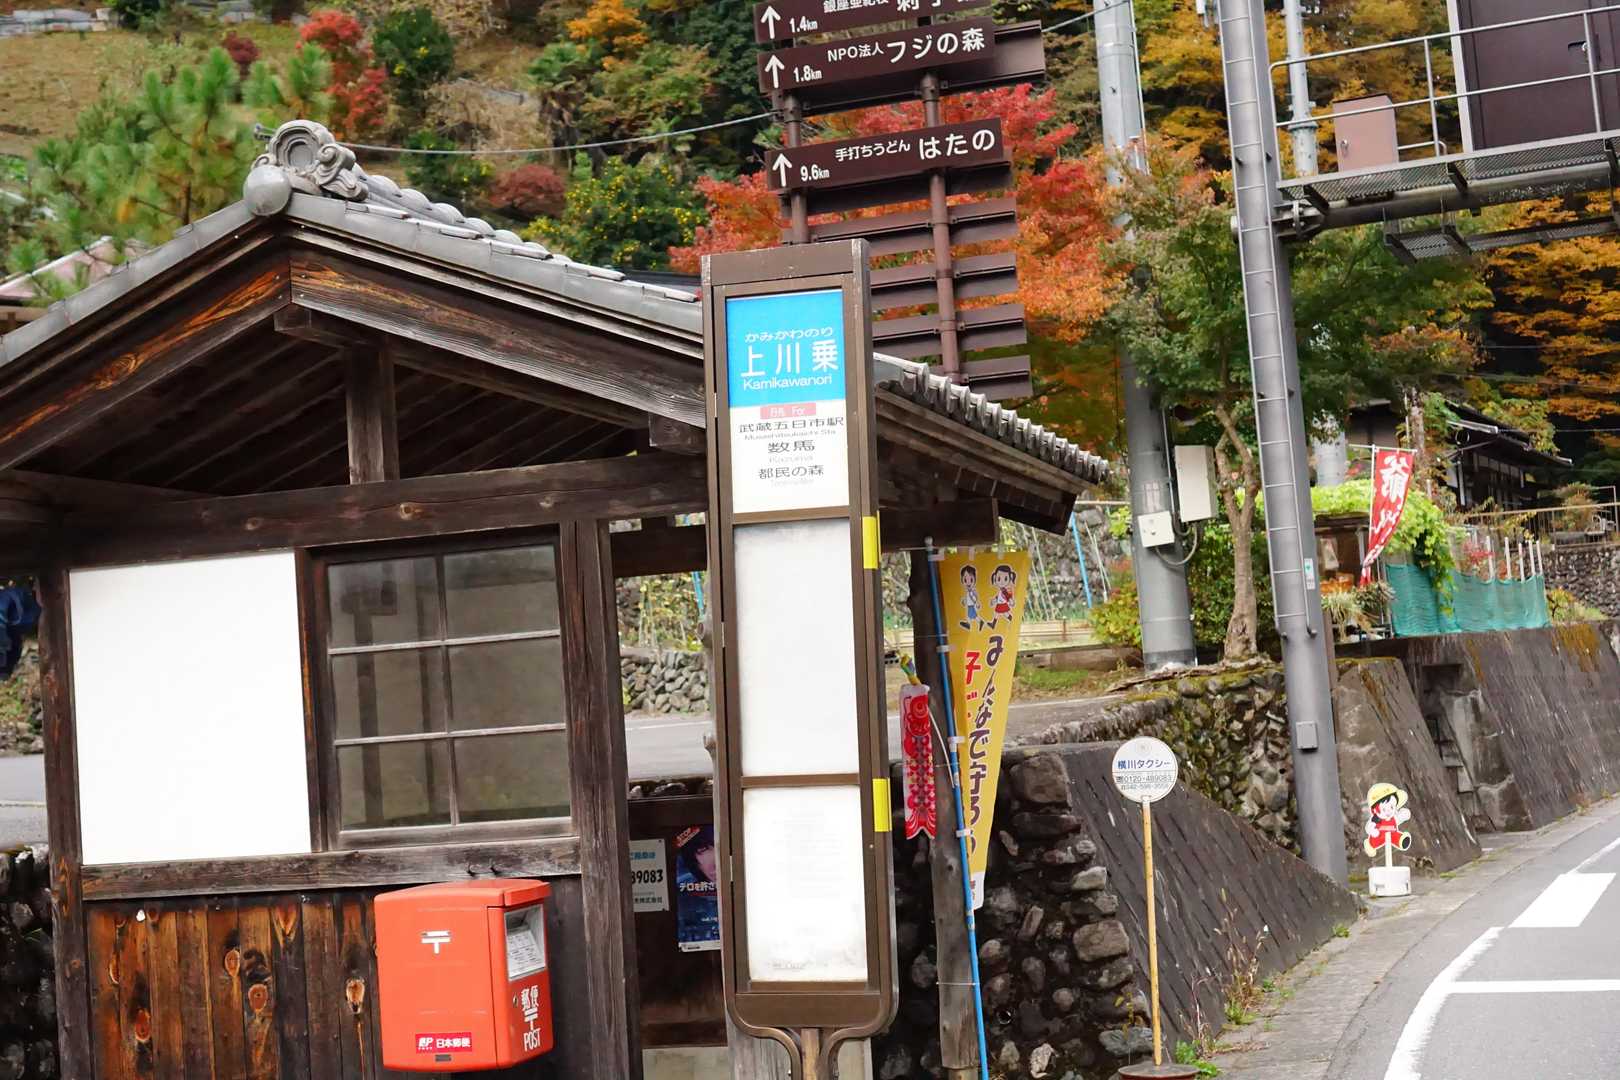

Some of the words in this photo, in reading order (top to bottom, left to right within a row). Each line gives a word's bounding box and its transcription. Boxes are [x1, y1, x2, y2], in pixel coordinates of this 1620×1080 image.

[789, 16, 818, 33] 1.4km
[887, 27, 985, 63] フジの森
[793, 65, 822, 83] 1.8km
[835, 139, 911, 162] 手打ちうどん
[919, 129, 995, 160] はたの
[800, 164, 830, 182] 9.6km
[744, 327, 833, 343] かみかわのり
[740, 339, 839, 378] 上川乗
[743, 375, 832, 391] Kamikawanori
[739, 417, 844, 433] 武蔵五日市駅
[768, 440, 815, 453] 数馬
[759, 464, 824, 479] 都民の森
[1117, 759, 1172, 769] 横川タクシー
[521, 985, 539, 1011] 郵便
[436, 1037, 471, 1048] 日本郵便
[523, 1028, 541, 1052] POST
